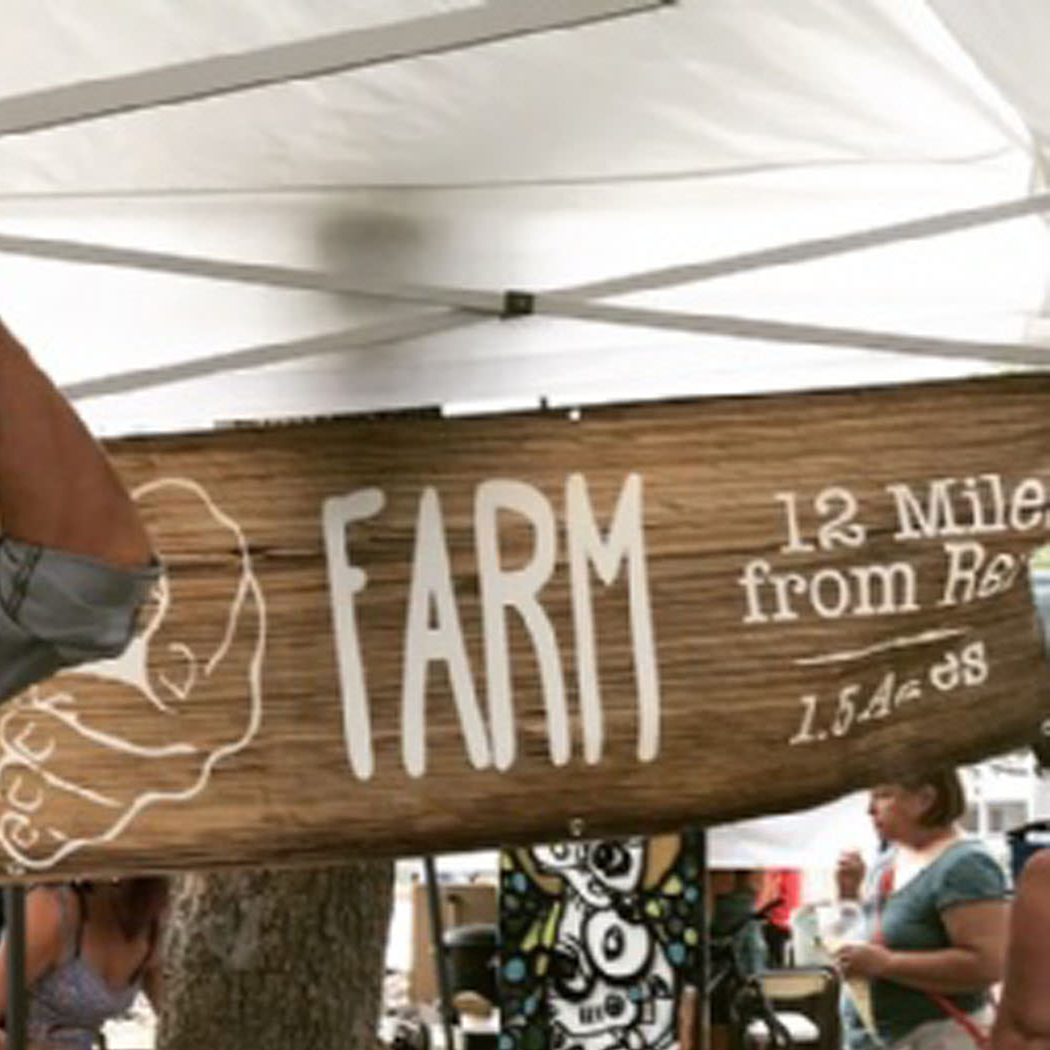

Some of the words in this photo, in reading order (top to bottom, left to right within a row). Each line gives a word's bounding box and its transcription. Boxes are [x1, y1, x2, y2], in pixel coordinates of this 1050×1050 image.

[773, 486, 867, 554] 12
[886, 473, 1050, 540] Mile
[321, 470, 661, 782] FARM
[737, 558, 921, 624] from
[856, 641, 990, 723] Aes
